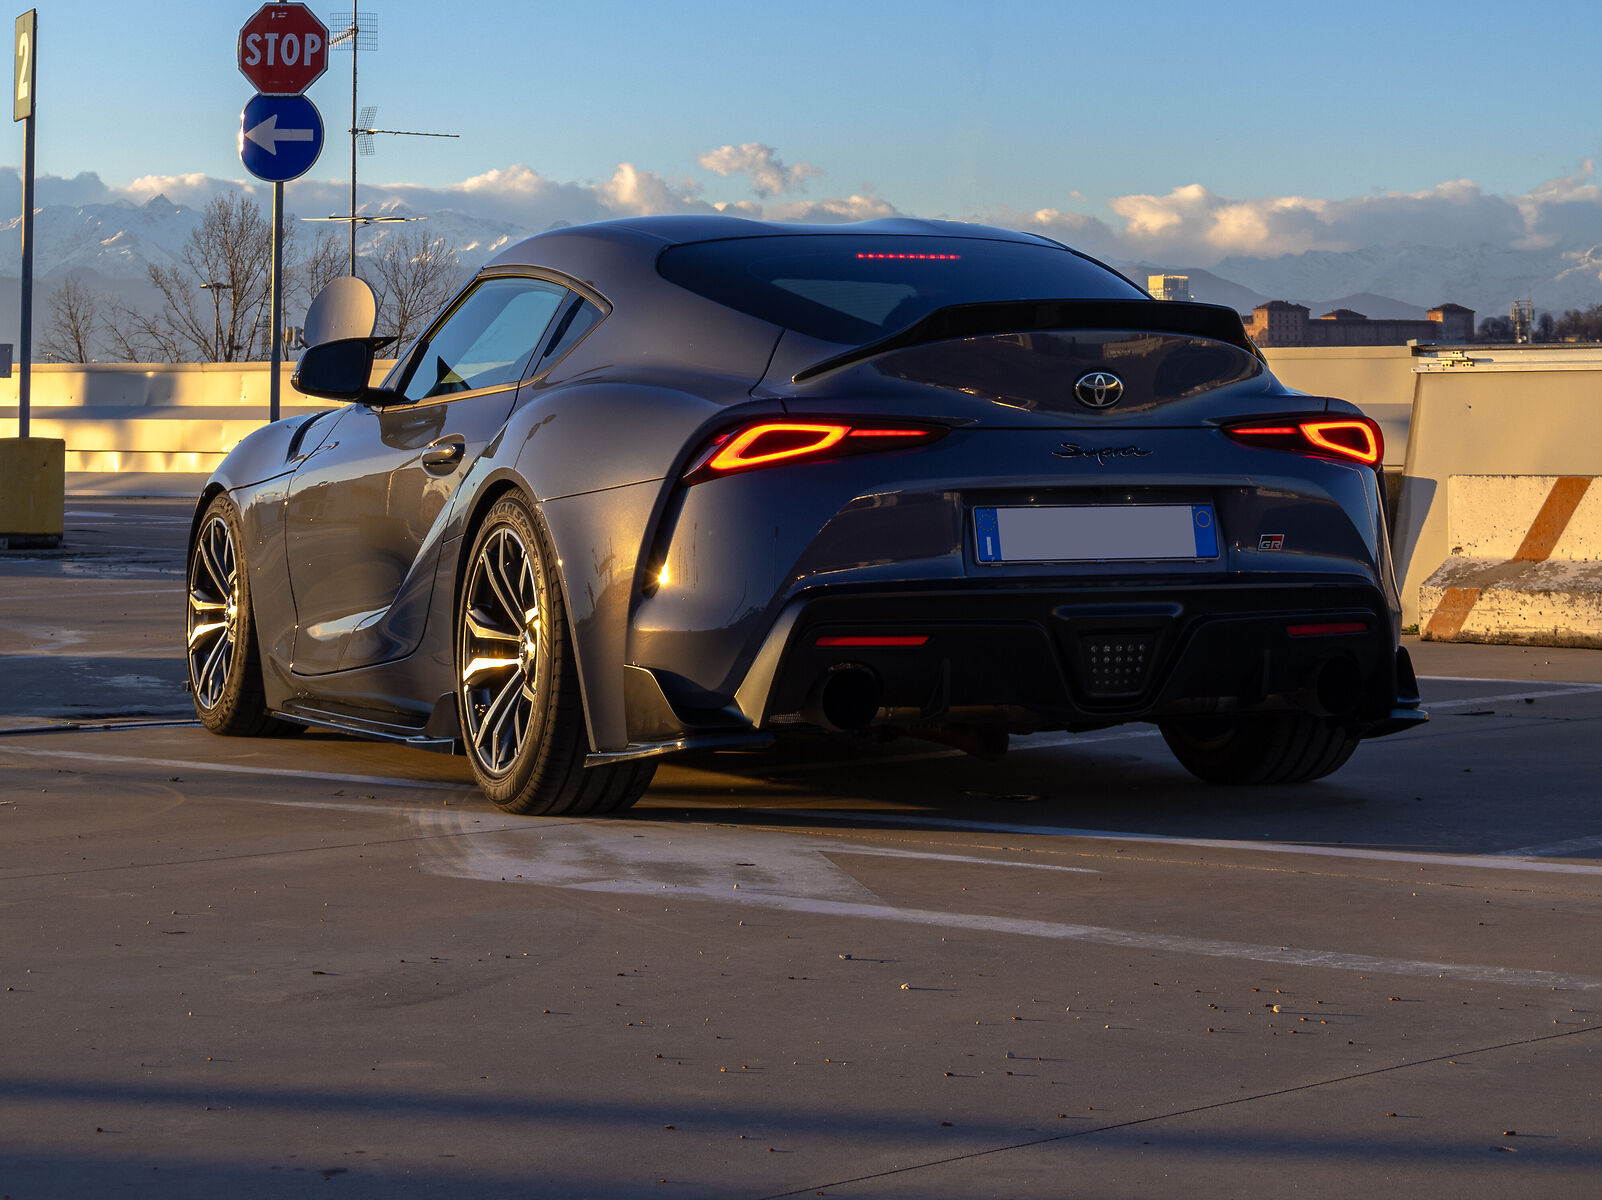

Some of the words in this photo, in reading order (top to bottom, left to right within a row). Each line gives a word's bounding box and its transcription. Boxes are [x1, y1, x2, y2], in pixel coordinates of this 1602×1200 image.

[245, 32, 321, 66] STOP
[17, 32, 29, 100] 2
[1051, 442, 1154, 467] Supra
[482, 502, 516, 526] DVAN
[986, 536, 993, 556] I
[1260, 540, 1281, 549] GR
